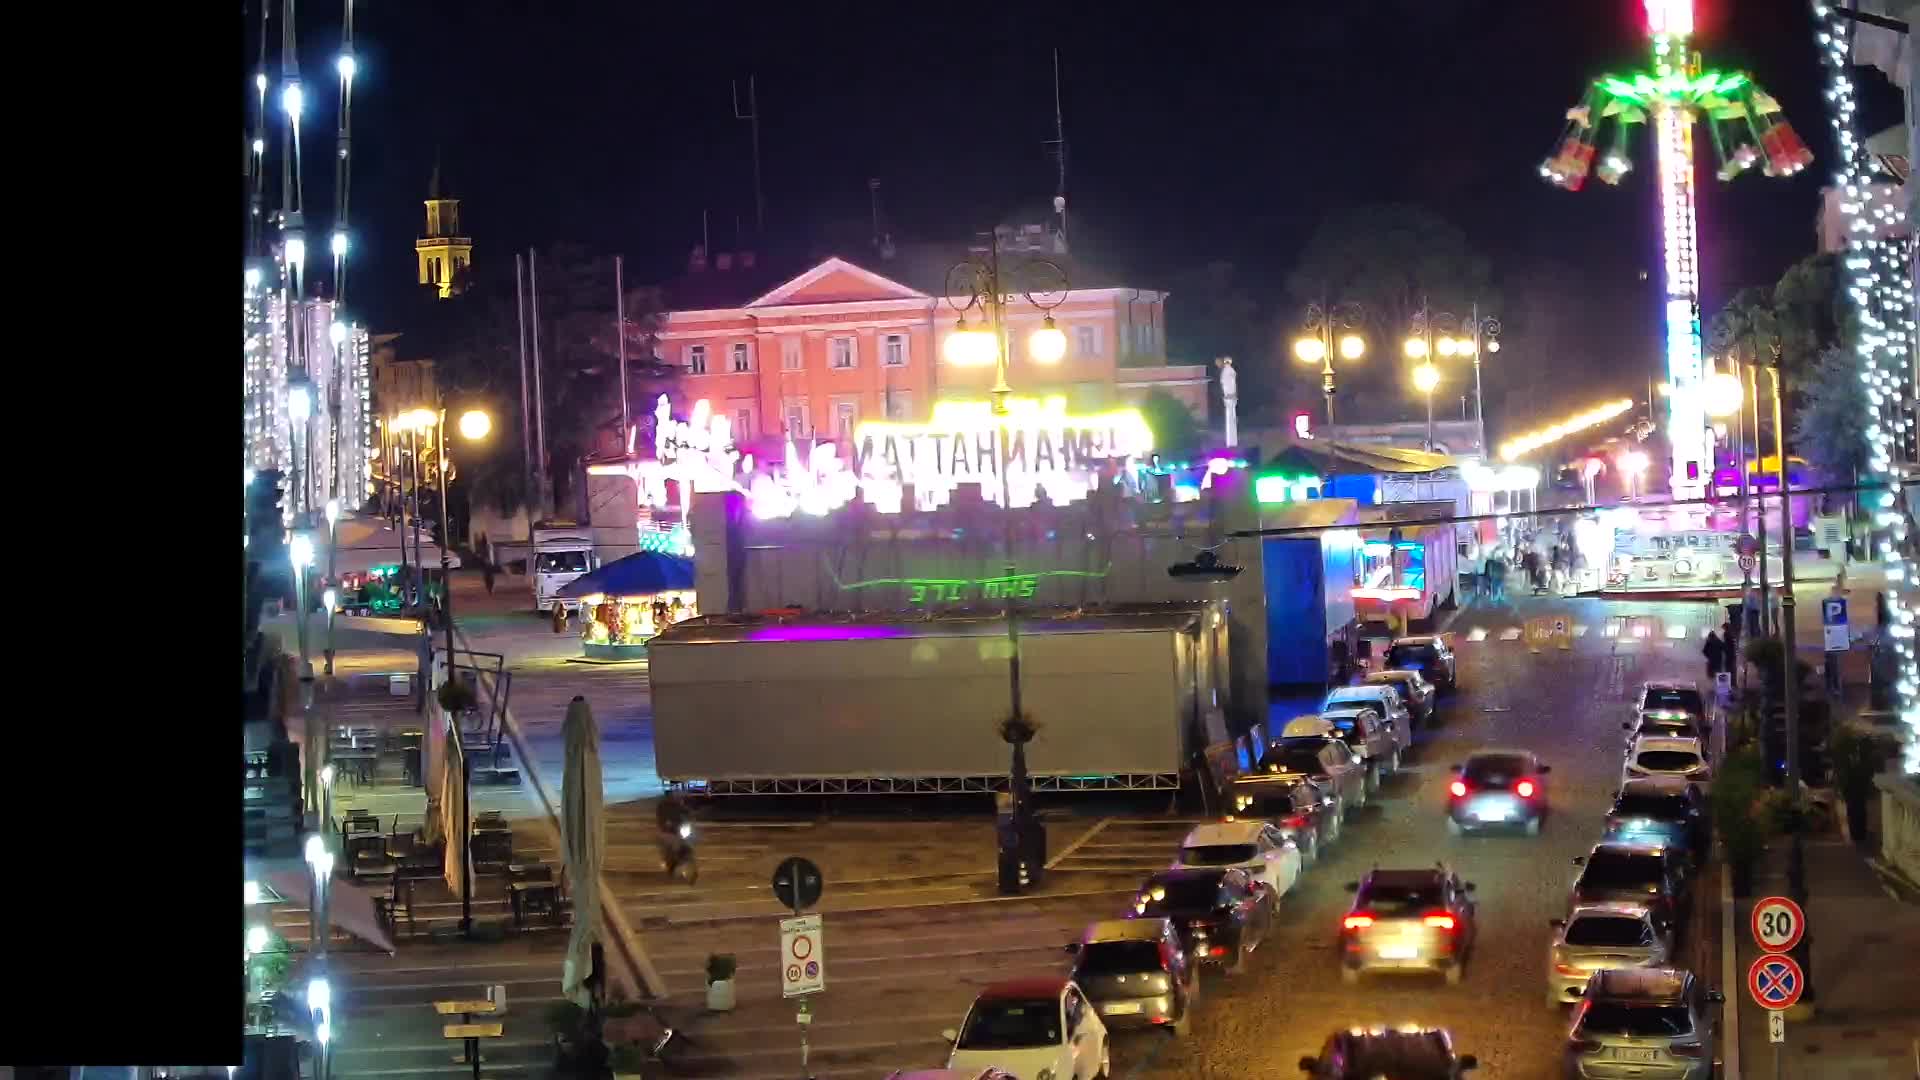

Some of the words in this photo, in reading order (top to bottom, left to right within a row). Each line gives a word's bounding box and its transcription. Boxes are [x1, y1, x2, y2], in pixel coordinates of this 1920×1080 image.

[910, 580, 1037, 602] SHUTLE
[1826, 602, 1842, 624] P
[1762, 911, 1792, 937] 30
